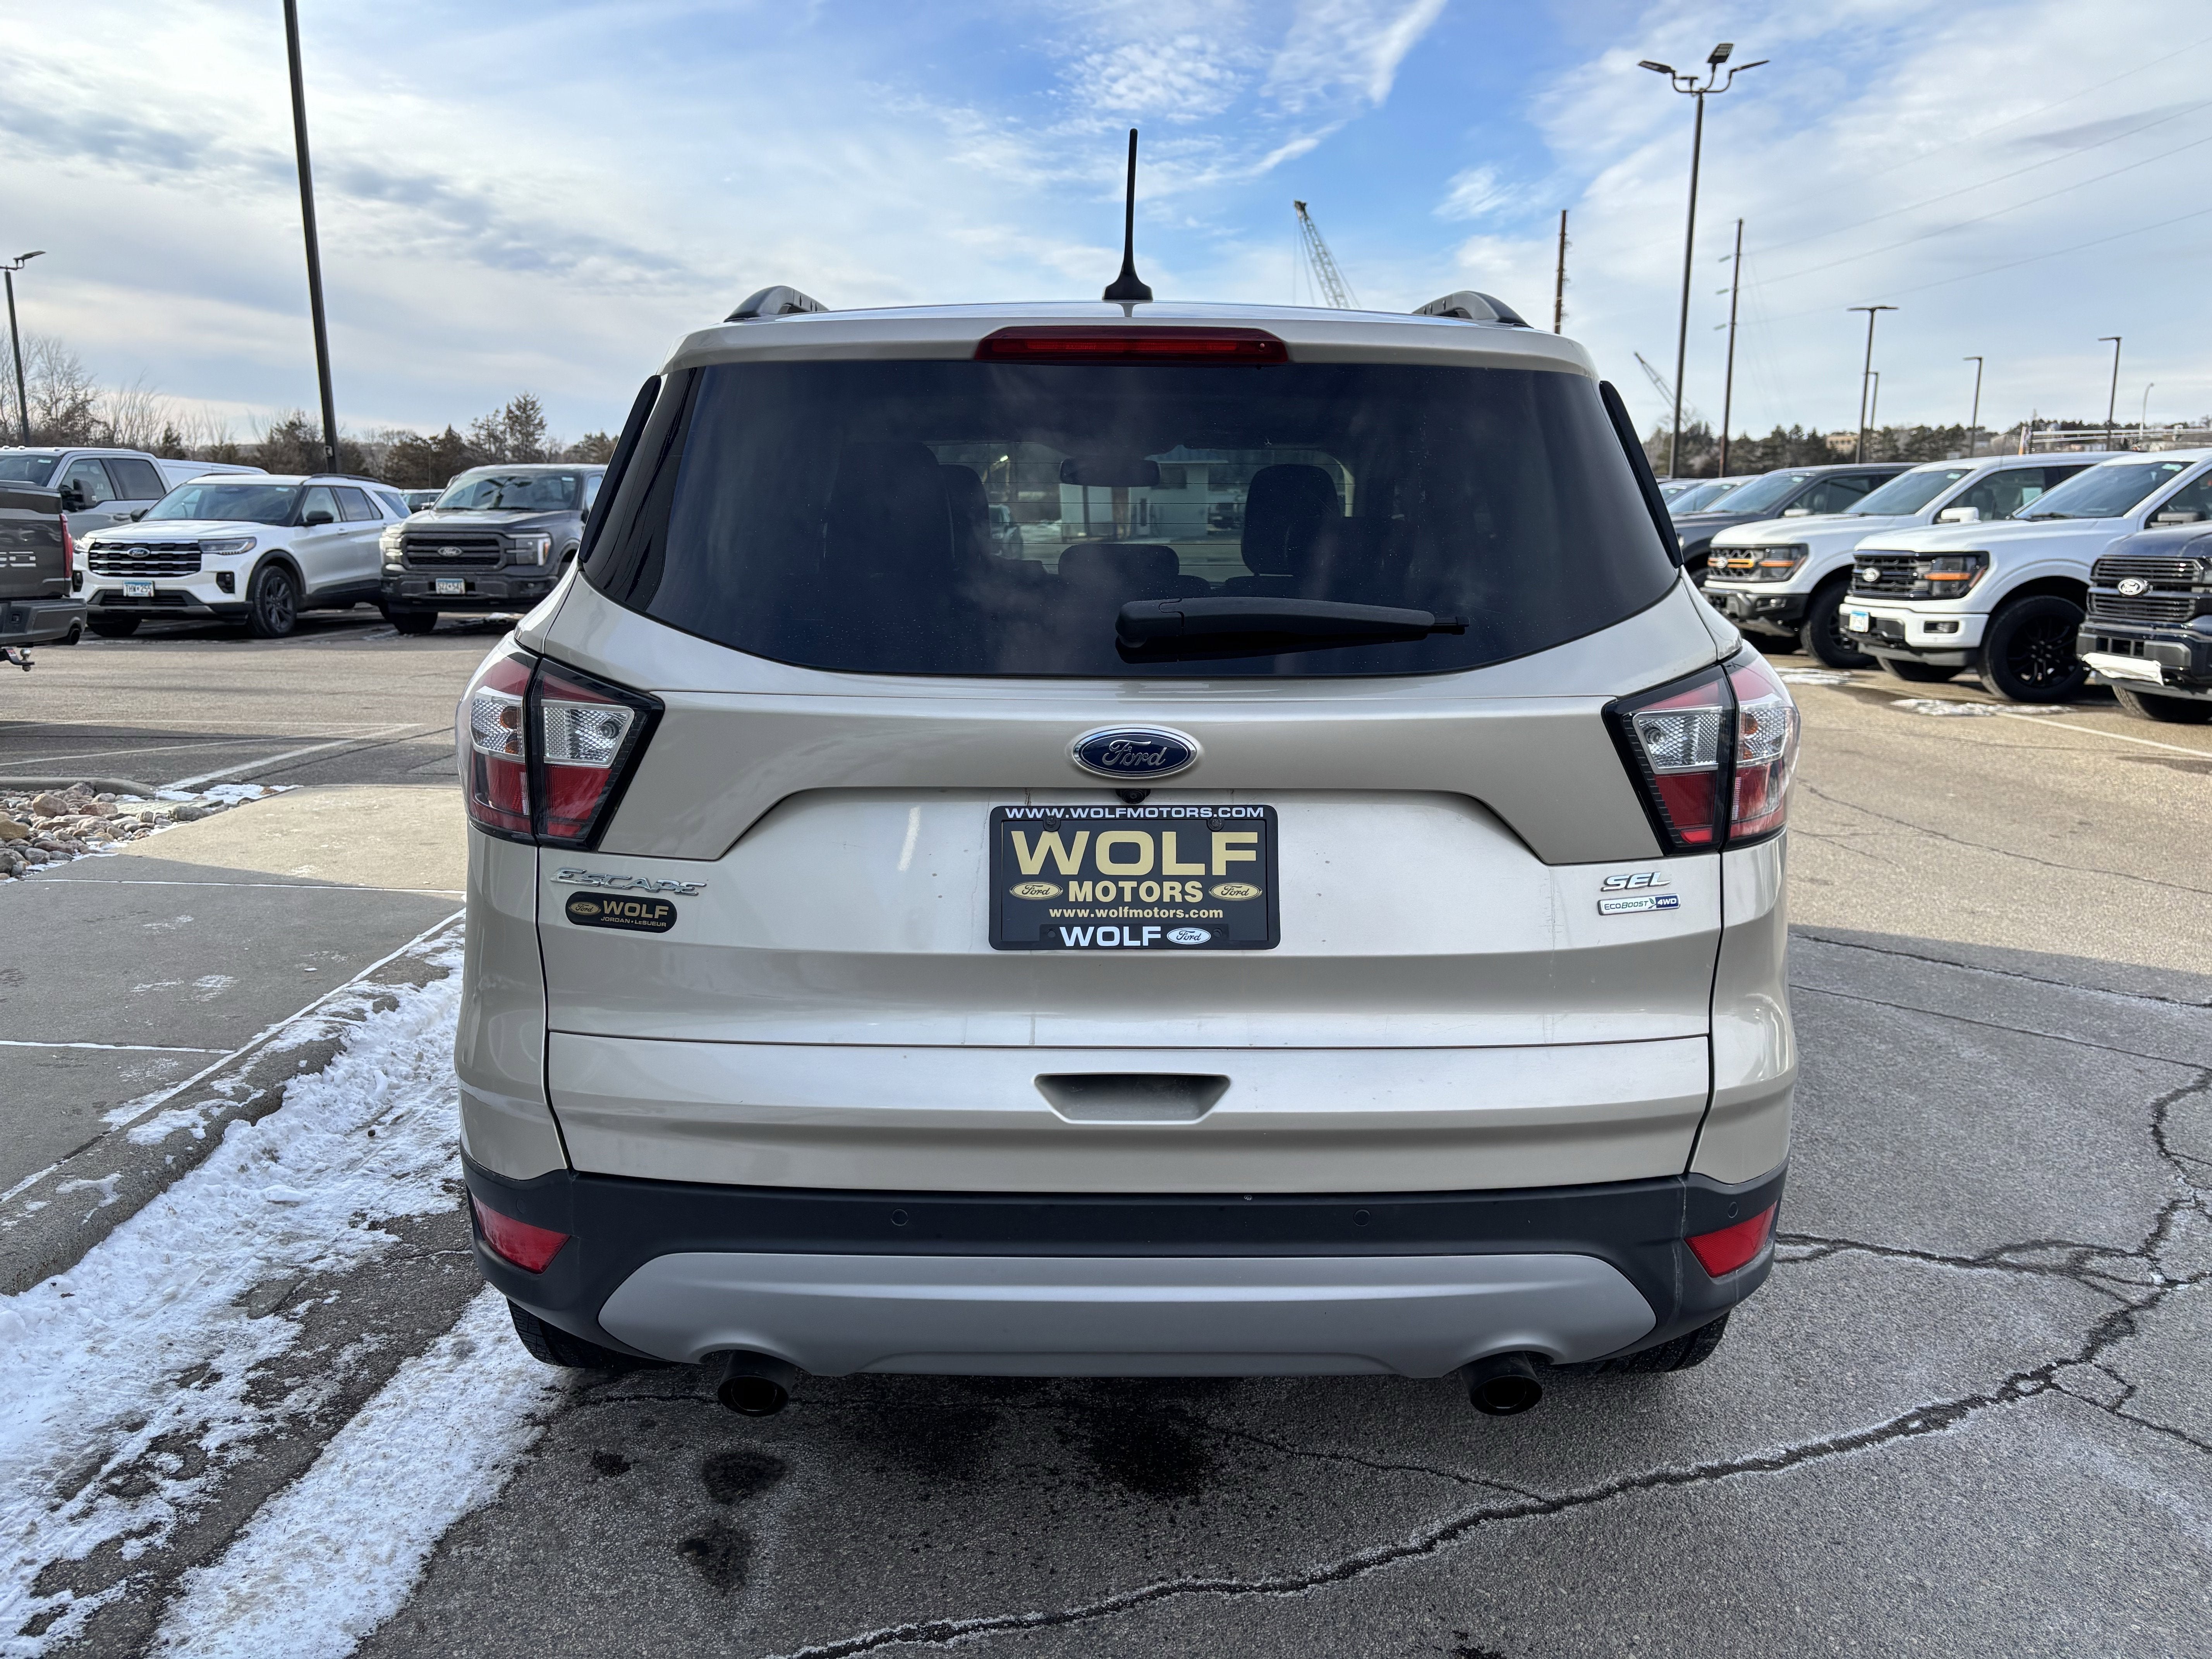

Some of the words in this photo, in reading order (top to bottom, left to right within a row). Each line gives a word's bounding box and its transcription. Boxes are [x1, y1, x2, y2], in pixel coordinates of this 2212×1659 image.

[1102, 739, 1168, 766] Ford
[1005, 807, 1264, 819] WWW.WOLFMOTORS.COM
[1011, 831, 1258, 876] WOLF
[550, 867, 707, 896] ESCAPE
[1601, 871, 1671, 892] SEL
[1022, 884, 1050, 895] Ford
[1068, 881, 1203, 902] MOTORS
[1221, 885, 1250, 896] Ford
[575, 903, 594, 912] Ford
[603, 900, 670, 919] WOLF
[1657, 898, 1677, 906] 4WD
[1049, 907, 1223, 919] www.wolfmotors.com
[1060, 926, 1161, 947] WOLF
[1176, 930, 1202, 941] Ford
